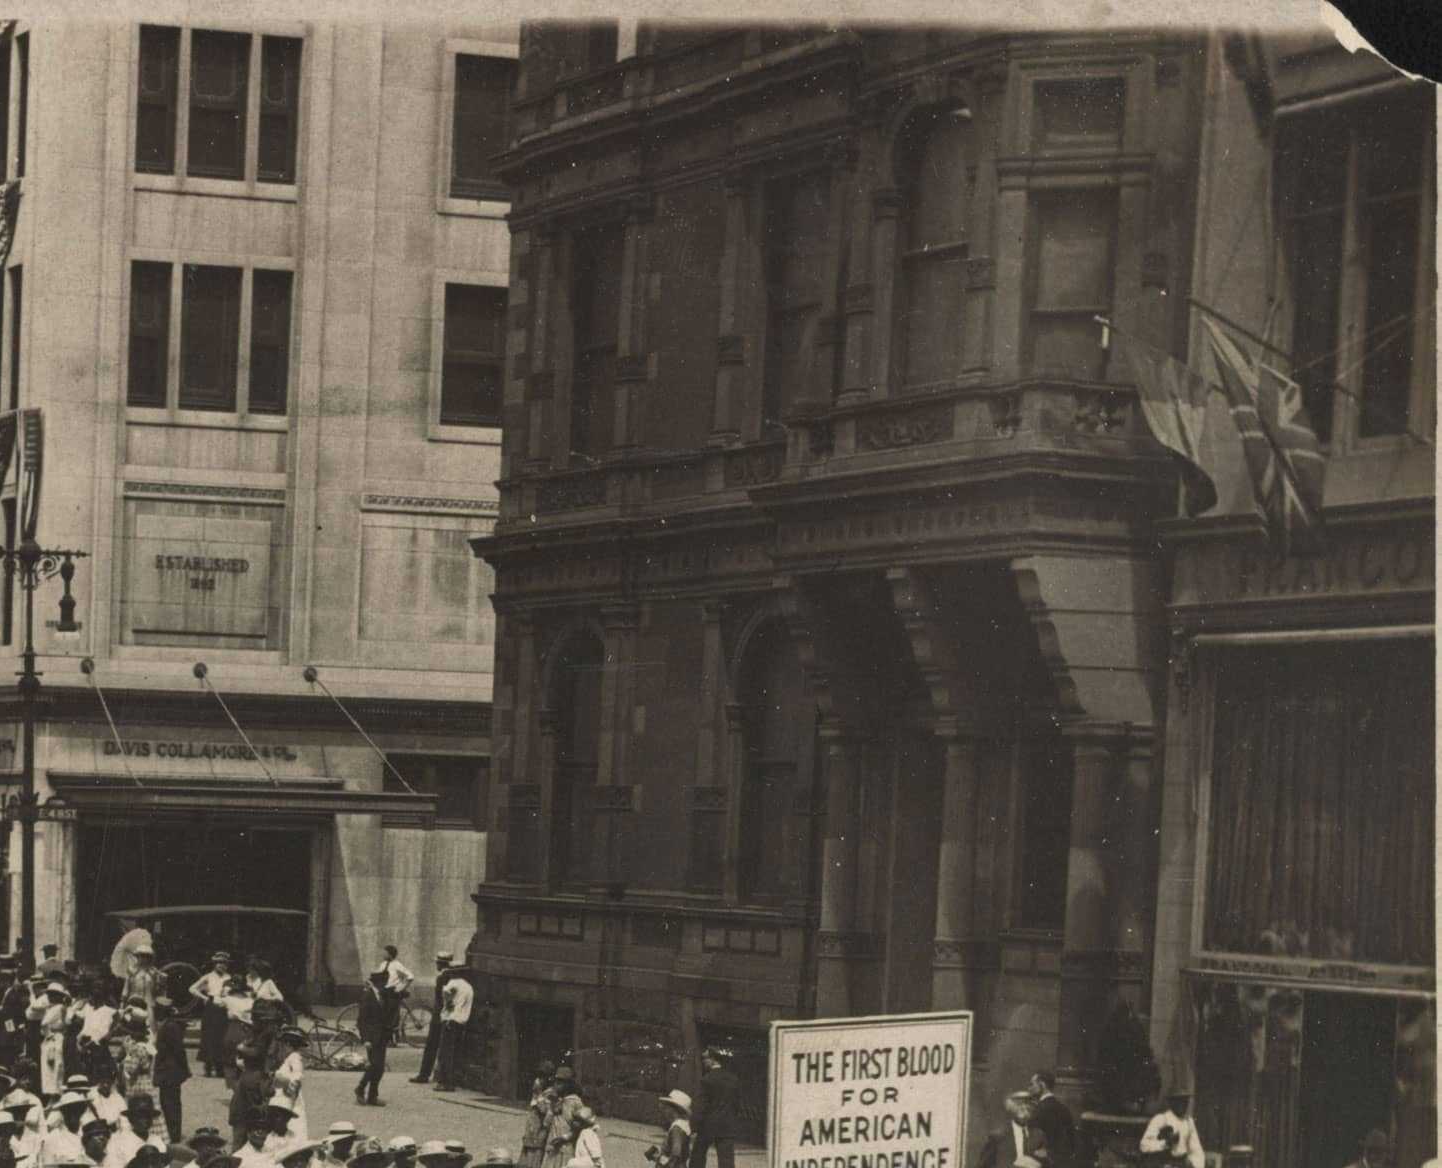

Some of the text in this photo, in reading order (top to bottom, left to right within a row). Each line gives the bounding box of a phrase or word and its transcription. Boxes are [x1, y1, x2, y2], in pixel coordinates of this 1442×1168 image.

[155, 554, 250, 573] ESTABLISHED
[103, 740, 150, 757] DAVIS
[791, 1043, 955, 1084] THE FIRST BLOOD
[841, 1087, 899, 1106] FOR
[799, 1111, 933, 1146] AMERICAN
